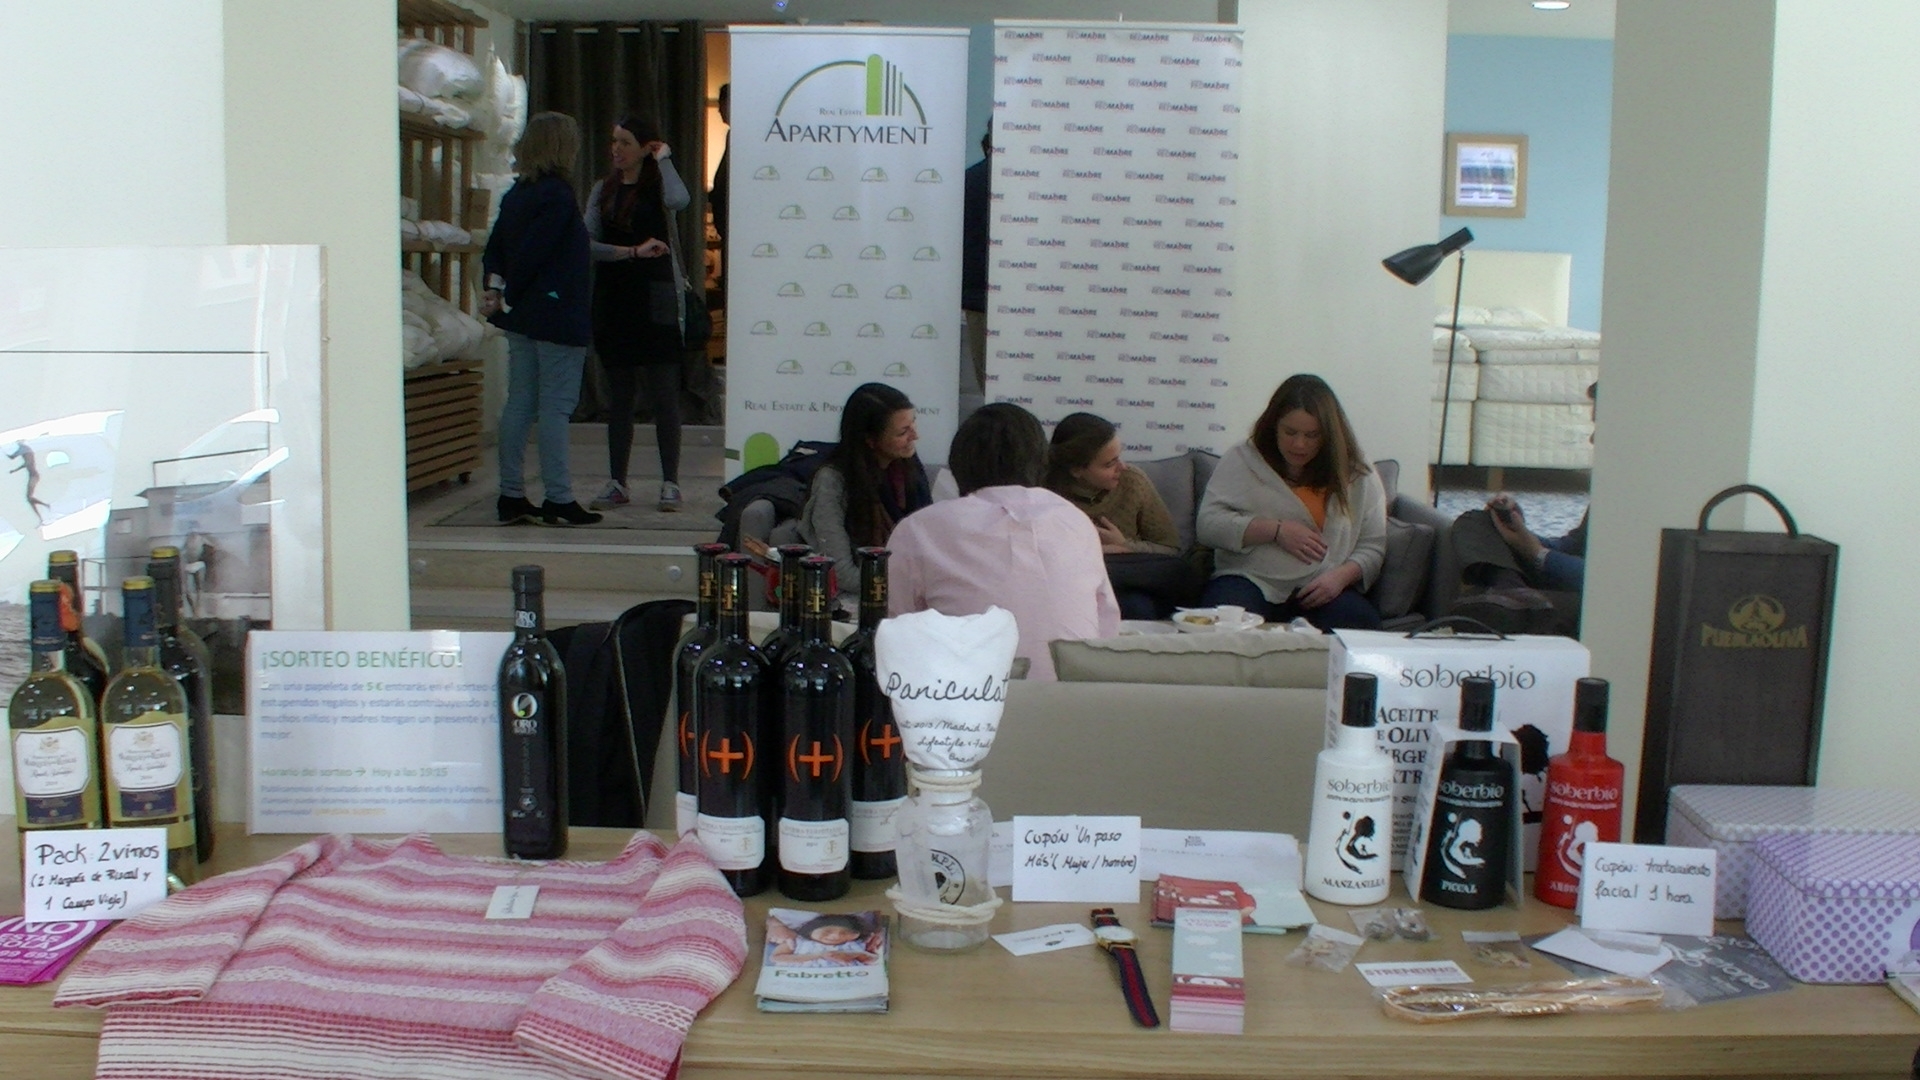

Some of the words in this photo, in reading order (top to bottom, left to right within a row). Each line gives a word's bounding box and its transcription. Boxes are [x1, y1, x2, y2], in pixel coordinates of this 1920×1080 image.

[764, 117, 933, 144] APARTYMENT
[808, 401, 820, 412] &
[367, 681, 374, 691] 5
[1595, 880, 1638, 900] facial
[774, 970, 869, 980] Fabretto
